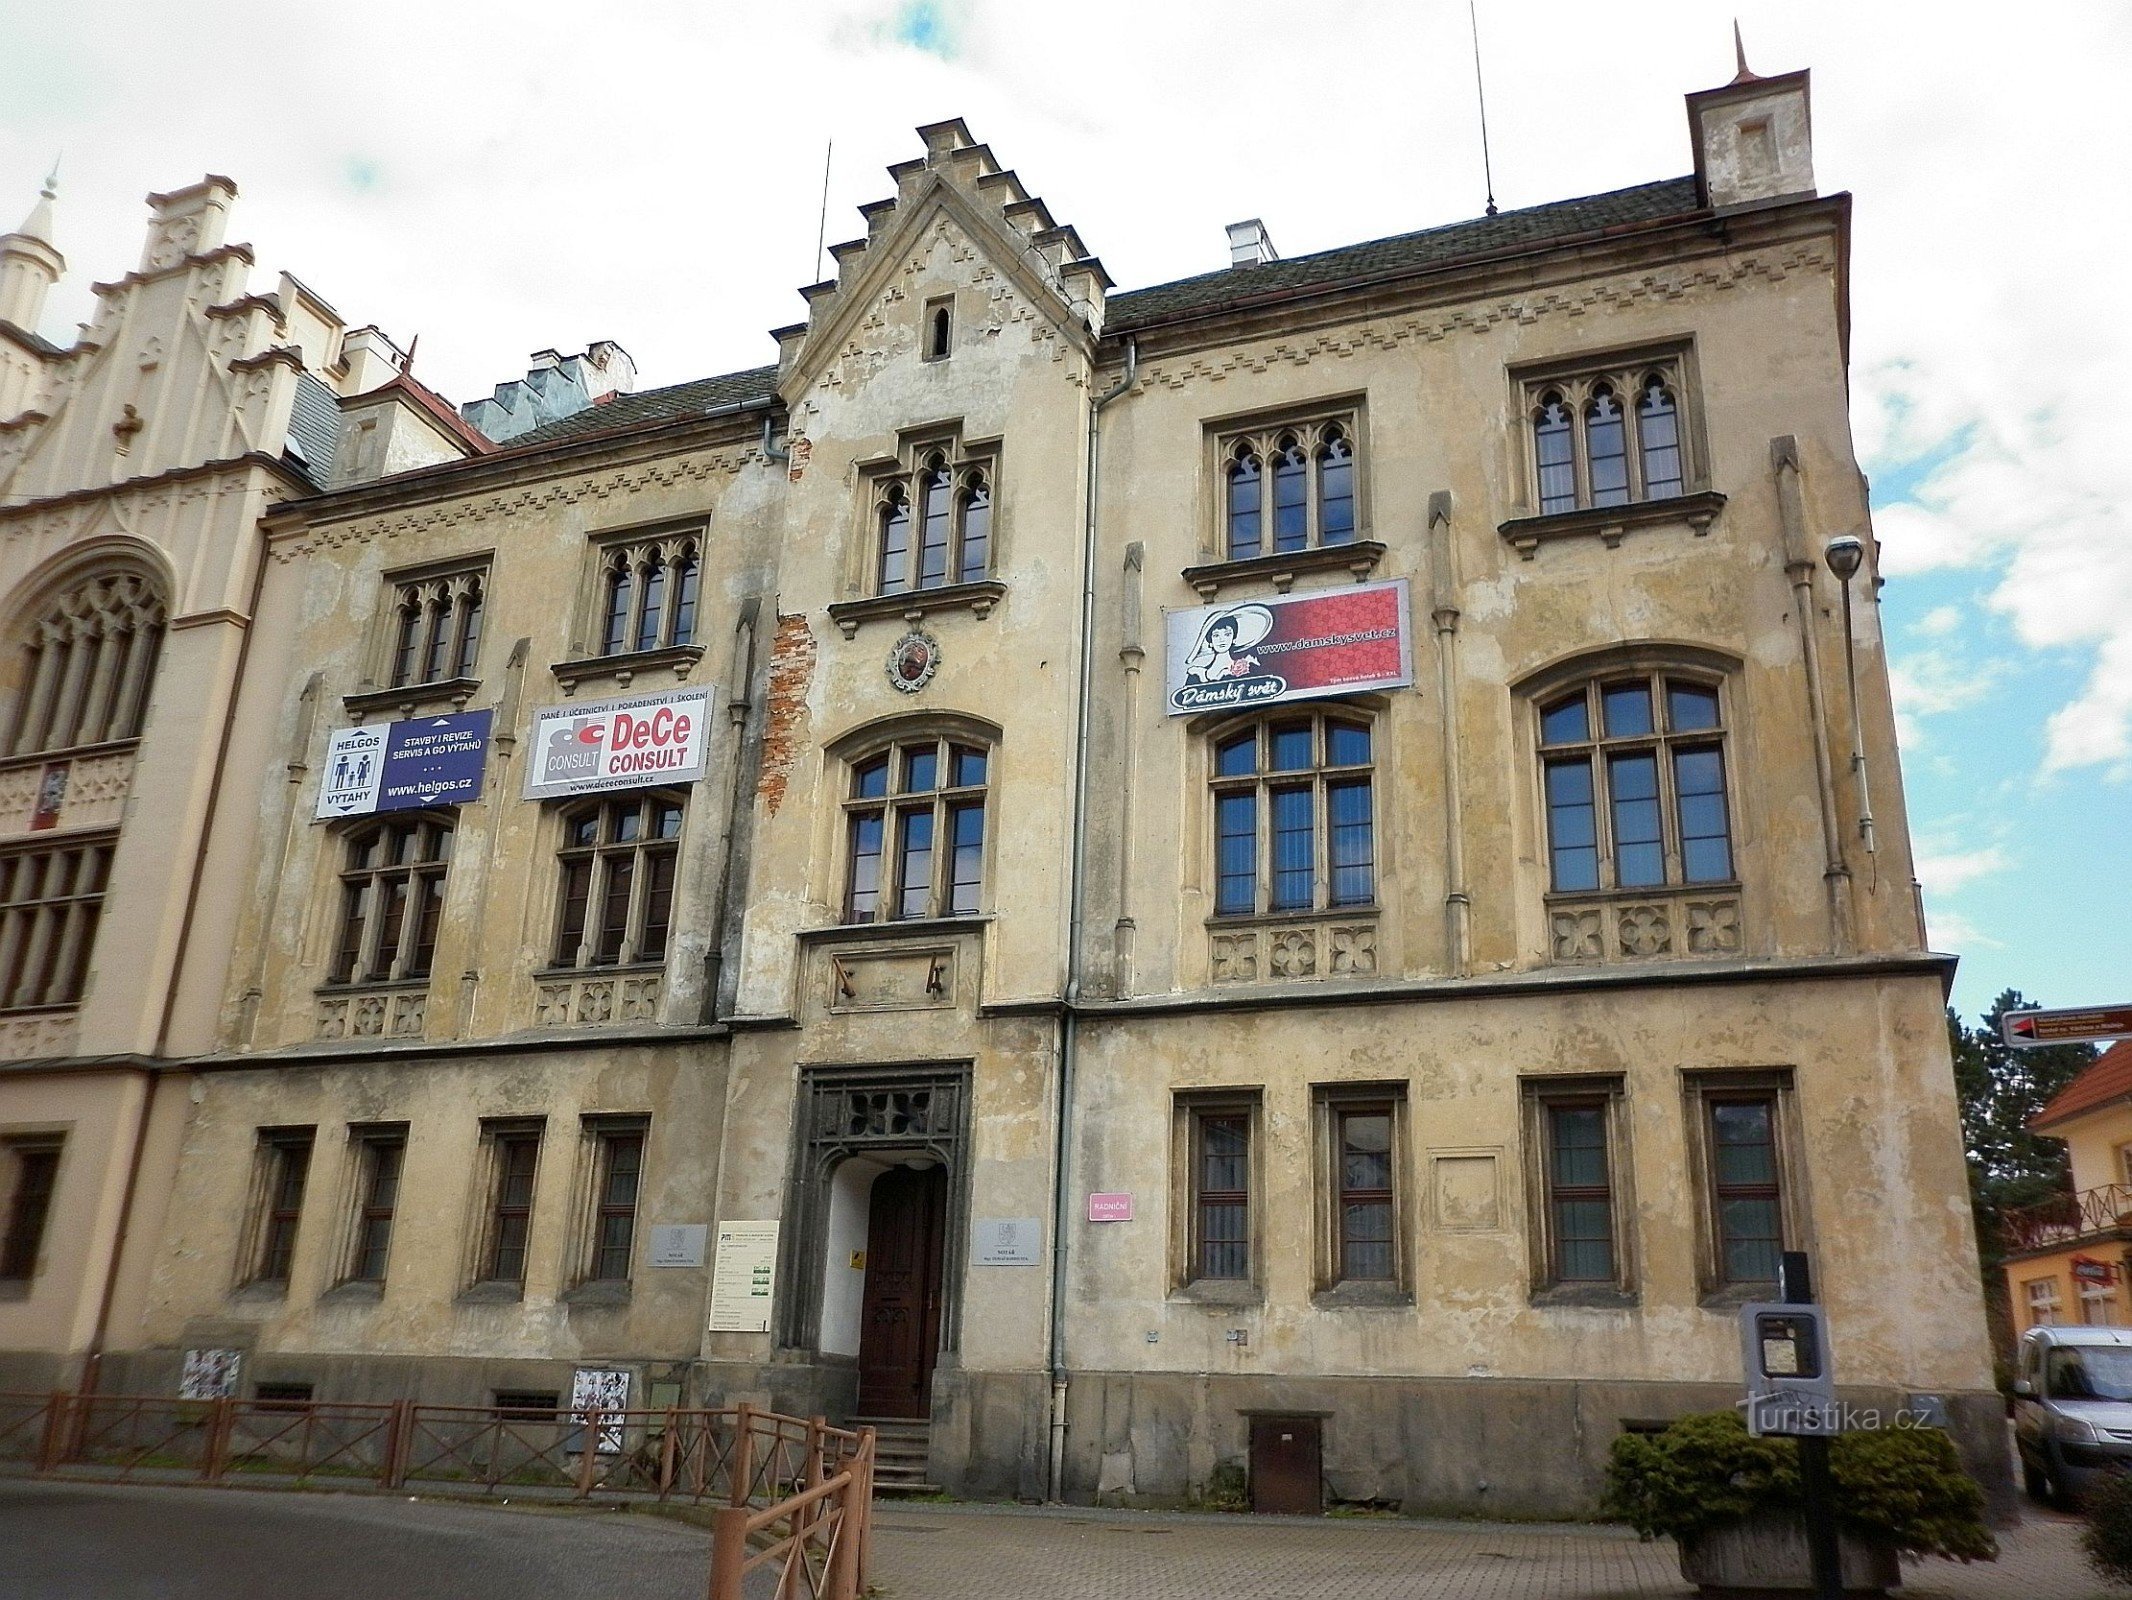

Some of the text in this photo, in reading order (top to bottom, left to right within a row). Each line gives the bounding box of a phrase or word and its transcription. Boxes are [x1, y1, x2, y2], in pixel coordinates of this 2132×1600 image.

[1257, 628, 1396, 654] www.damskysvet.cz
[569, 704, 608, 716] ÚČETNICTVÍ
[618, 696, 668, 711] PORADENSTVÍ
[677, 690, 708, 703] ŠKOLENÍ
[1182, 681, 1278, 704] Dámský svět
[404, 735, 437, 748] STAVBY
[443, 730, 474, 743] REVIZE
[611, 707, 691, 751] DeCe
[336, 736, 380, 751] HELGOS
[392, 739, 482, 760] SERVIS A GO VÝTAHŮ
[549, 751, 599, 772] CONSULT
[608, 747, 688, 775] CONSULT
[388, 778, 472, 797] www.helgos.cz
[570, 775, 654, 792] www.dececonsult.cz
[327, 791, 371, 805] VÝTAHY
[1094, 1201, 1128, 1210] RADNIČNÍ
